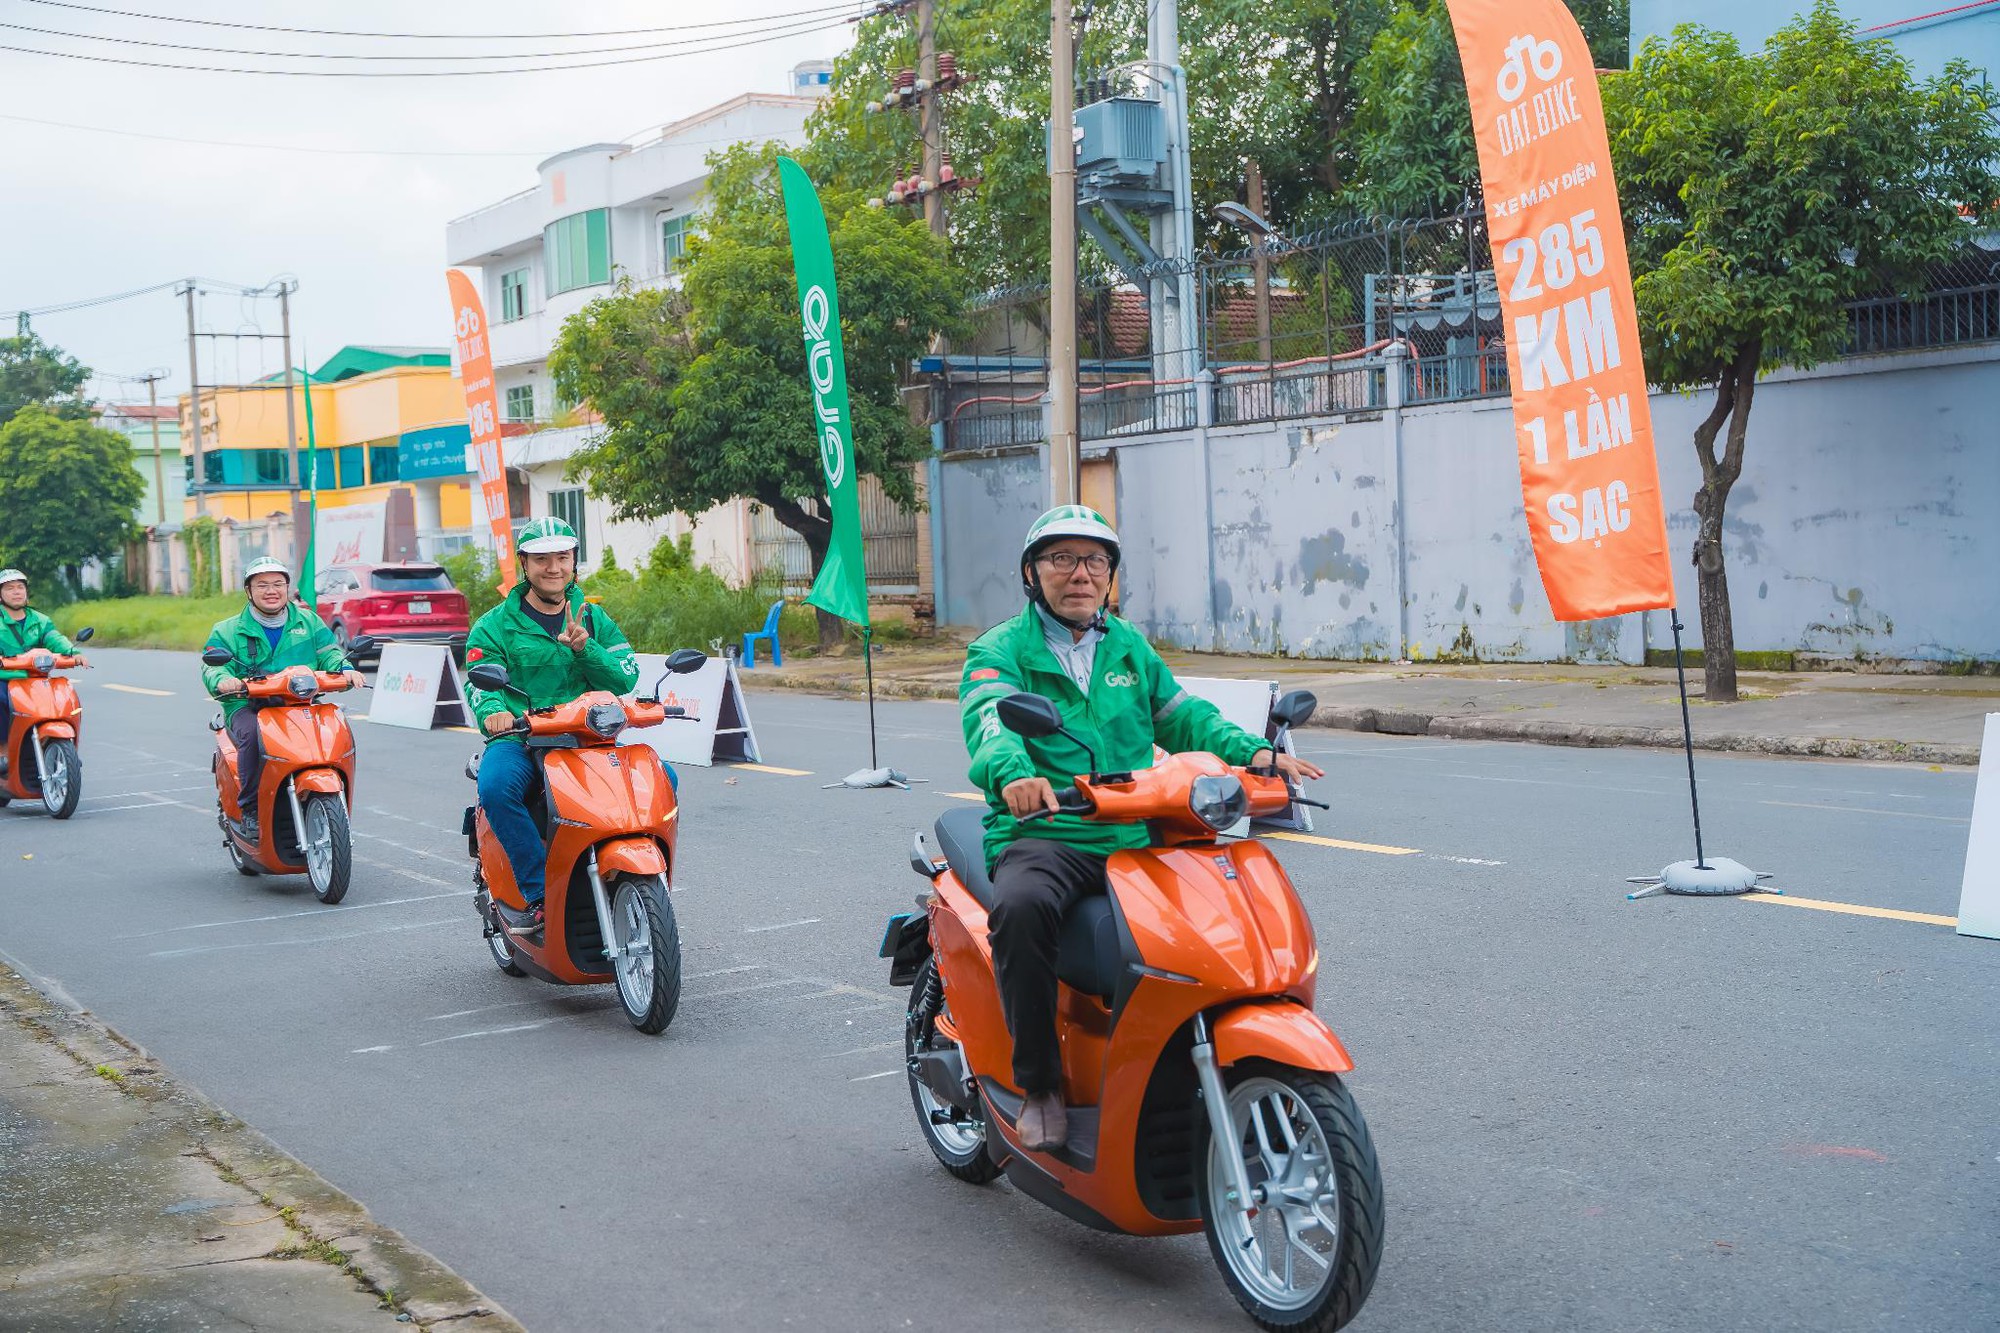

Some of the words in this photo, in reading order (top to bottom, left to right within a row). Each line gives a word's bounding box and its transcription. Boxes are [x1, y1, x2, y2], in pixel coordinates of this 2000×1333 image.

[1496, 77, 1582, 157] DAT.BIKE
[1492, 197, 1519, 218] XE
[1520, 176, 1559, 209] MÁY
[1561, 161, 1598, 191] ĐIỆN
[1503, 208, 1605, 302] 285
[1514, 286, 1622, 392] KM
[803, 284, 845, 489] Grab
[1523, 416, 1549, 465] 1
[1563, 386, 1633, 461] LẦN
[1546, 479, 1631, 548] SẠC
[1104, 670, 1139, 688] Grab
